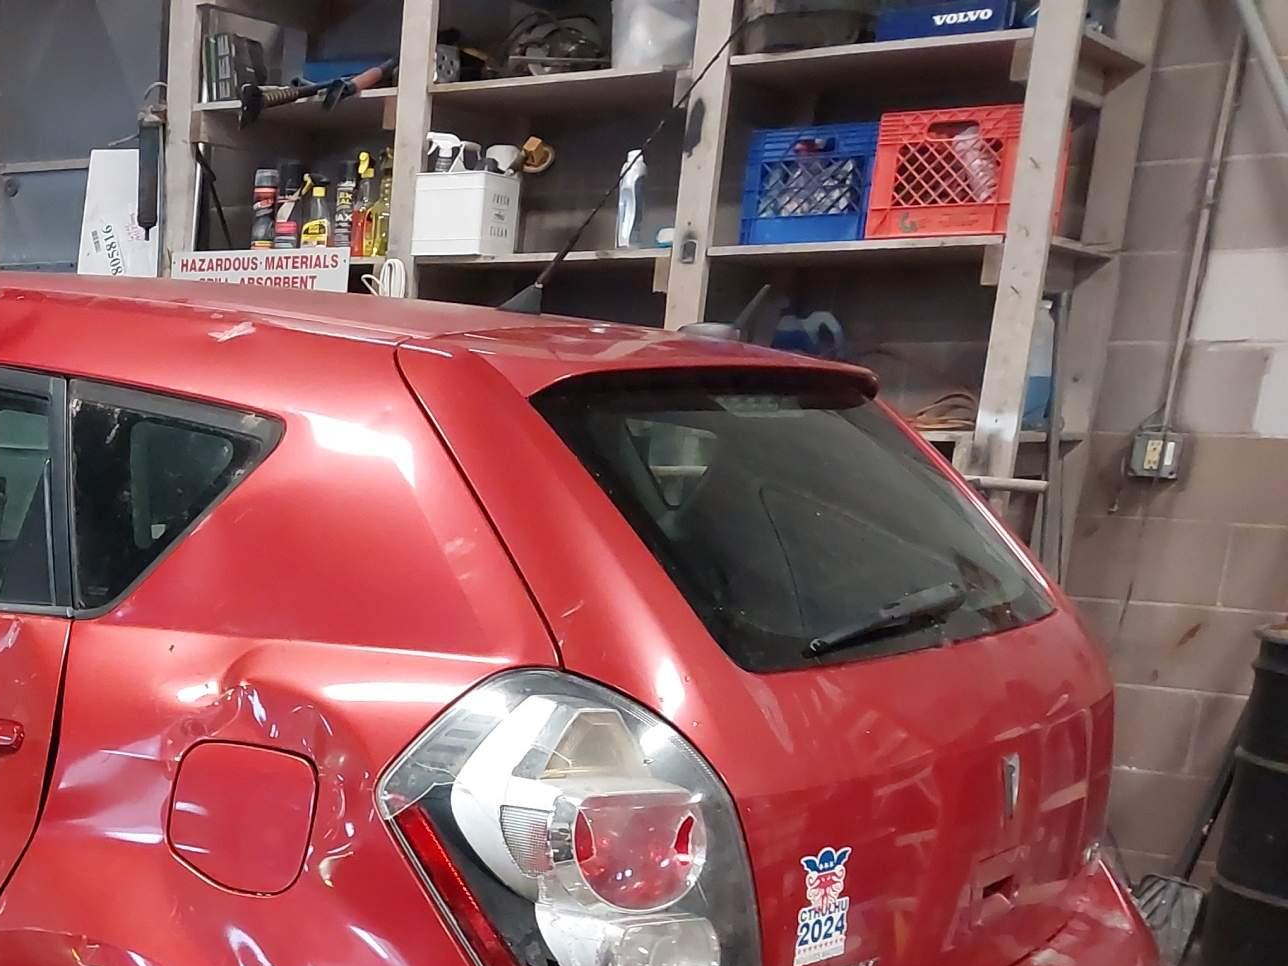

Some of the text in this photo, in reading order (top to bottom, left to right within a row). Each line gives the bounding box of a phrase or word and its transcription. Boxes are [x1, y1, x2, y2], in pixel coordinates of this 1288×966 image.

[932, 8, 993, 26] VOLVO
[102, 223, 123, 276] 805816
[180, 254, 339, 272] HAZARDOUS MATERIALS
[799, 900, 848, 922] CTHULHU
[798, 913, 845, 947] 2024
